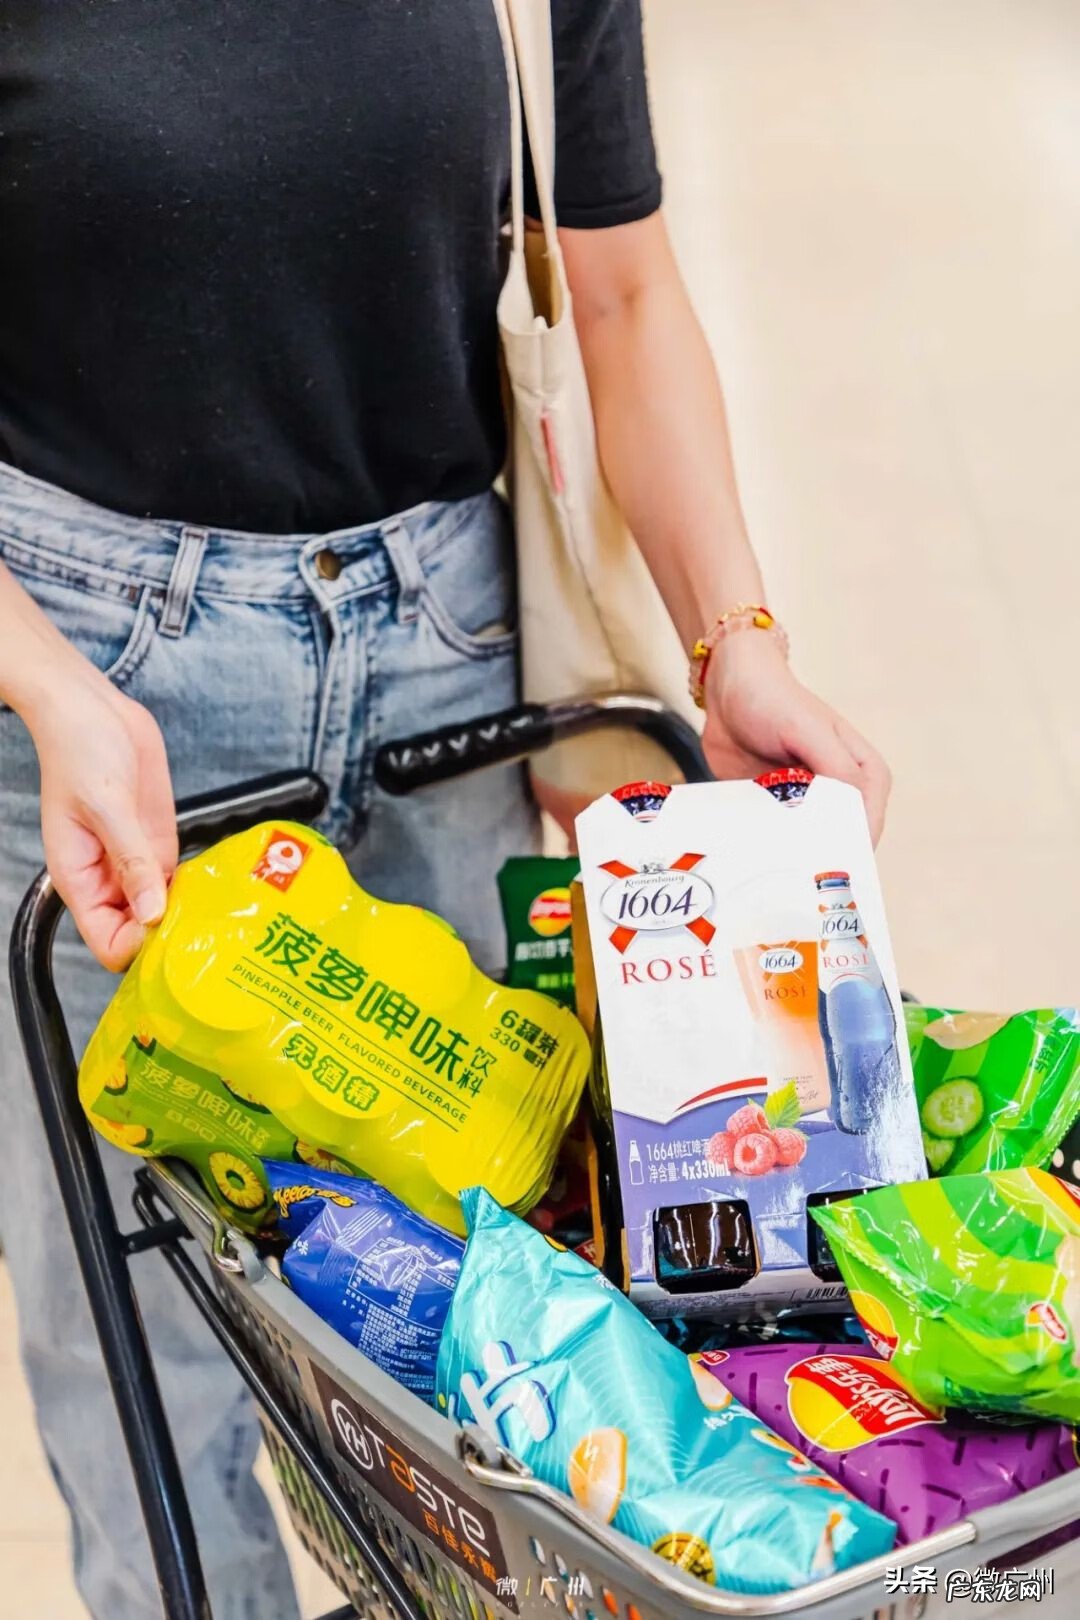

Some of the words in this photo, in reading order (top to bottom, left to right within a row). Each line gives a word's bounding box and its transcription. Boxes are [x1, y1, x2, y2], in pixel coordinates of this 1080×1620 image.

[618, 882, 698, 920] 1664
[821, 914, 860, 935] 1664
[620, 949, 717, 984] ROSÉ
[764, 953, 798, 969] 1664
[255, 911, 470, 1082] 菠萝啤味
[232, 962, 302, 1012] PINEAPPLE
[302, 1006, 335, 1034] BEER
[337, 1032, 401, 1080] FLAVORED
[402, 1075, 469, 1124] BEVERAGE
[489, 1026, 521, 1053] 330
